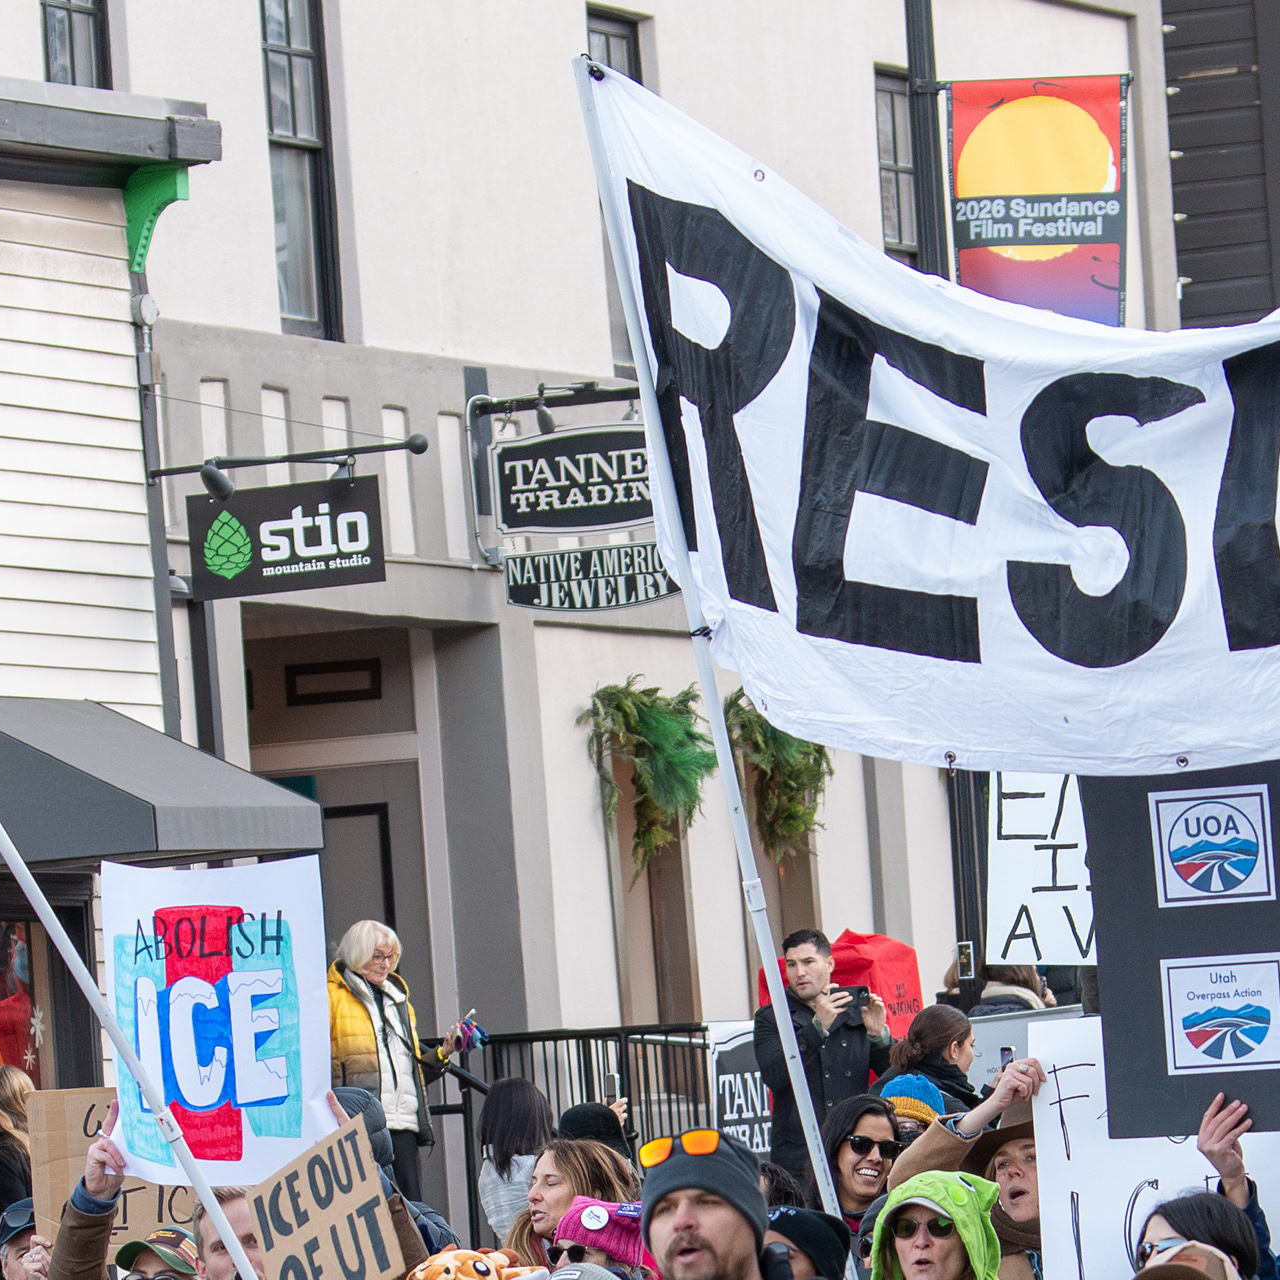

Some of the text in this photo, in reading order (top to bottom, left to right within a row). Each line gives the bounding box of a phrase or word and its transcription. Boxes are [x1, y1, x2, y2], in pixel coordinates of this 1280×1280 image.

[955, 197, 1120, 221] 2026 Sundance
[969, 216, 1103, 240] Film Festival
[504, 447, 648, 490] TANNE
[510, 481, 652, 513] TRADIN
[259, 502, 370, 562] stio
[262, 554, 371, 577] mountain studio
[507, 545, 666, 586] NATIVE AMERIC
[533, 573, 670, 609] JEWELRY
[1184, 814, 1241, 838] UOA
[133, 909, 284, 966] ABOLISH
[1209, 969, 1237, 984] Utah
[1186, 987, 1262, 1002] Overpass Action
[133, 967, 291, 1113] ICE
[253, 1128, 367, 1253] ICE OUT
